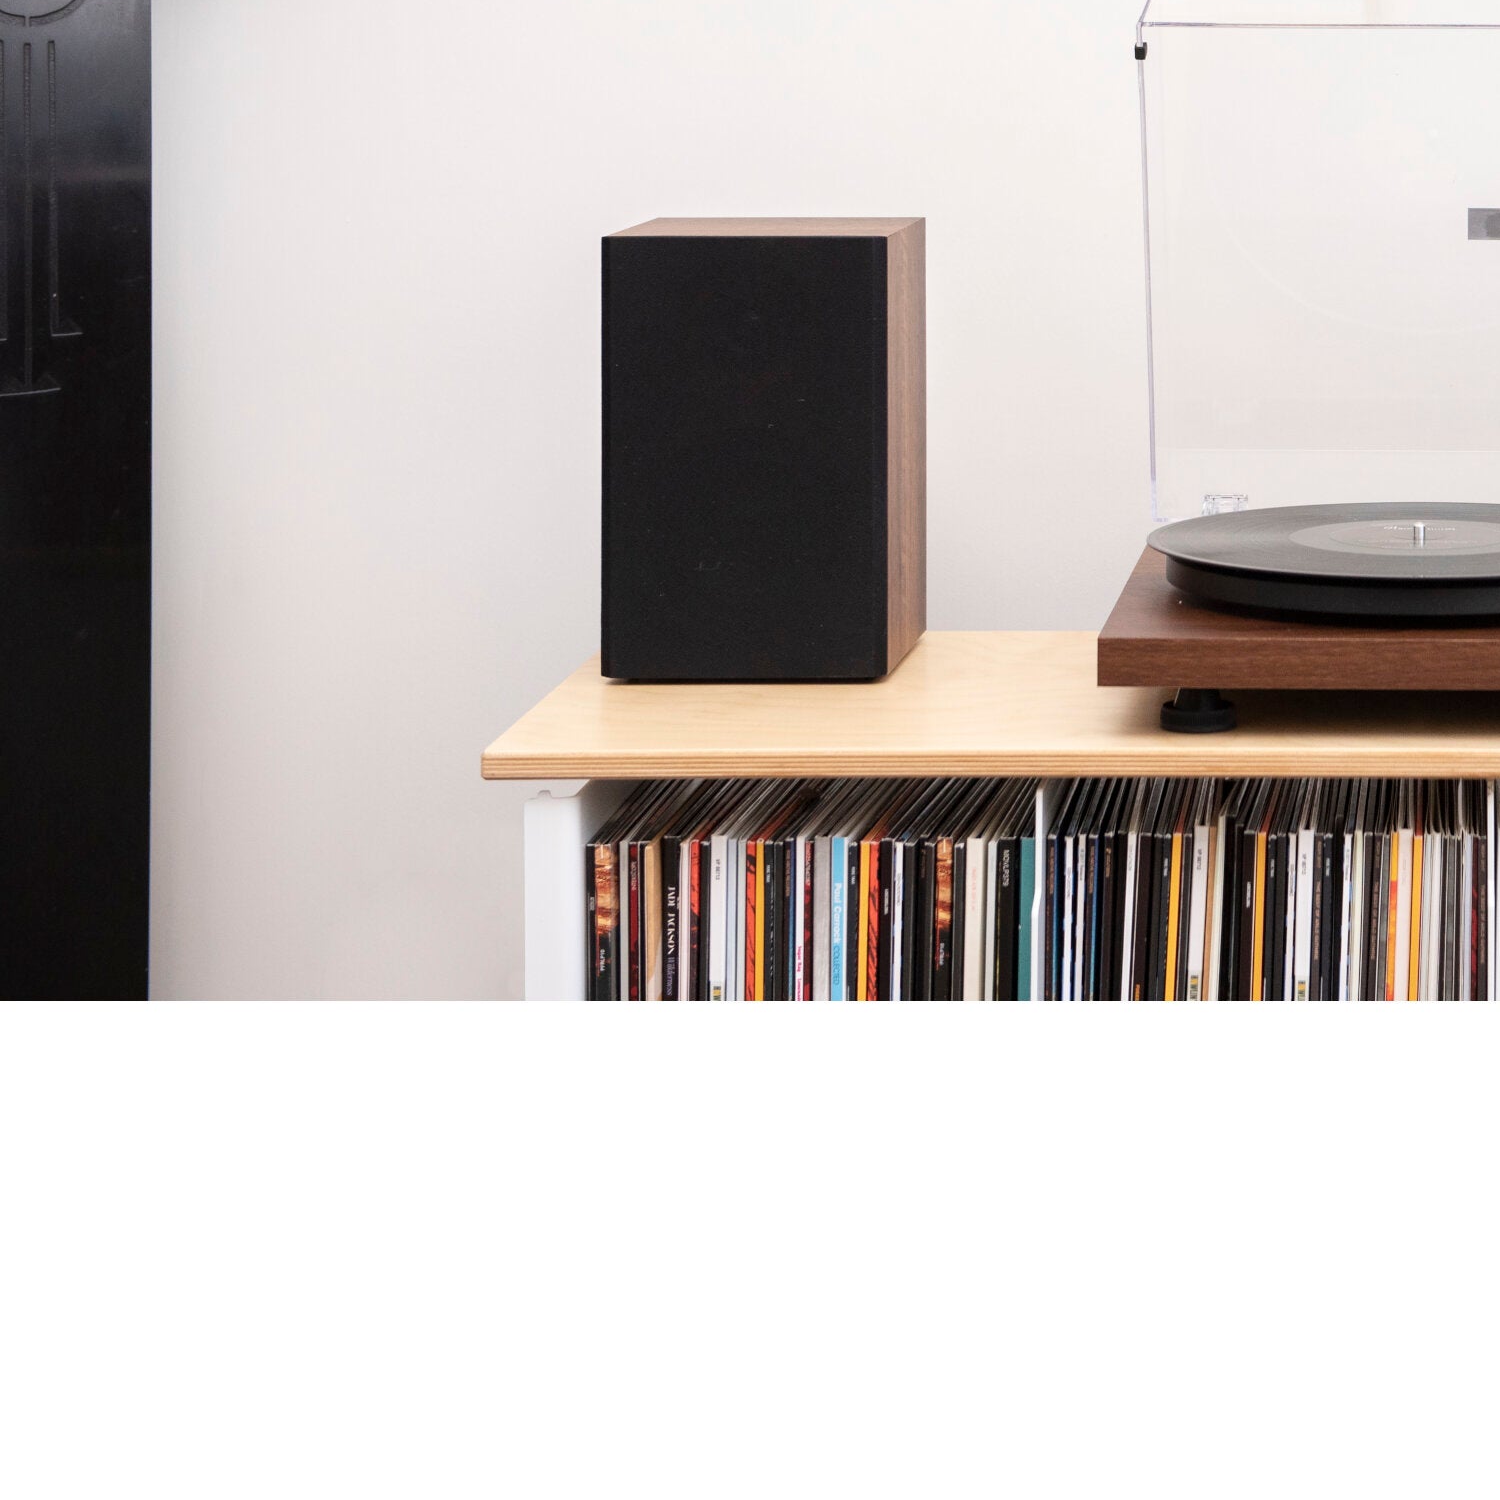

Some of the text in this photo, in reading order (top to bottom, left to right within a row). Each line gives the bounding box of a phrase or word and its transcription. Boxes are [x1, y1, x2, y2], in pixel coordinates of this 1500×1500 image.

[665, 886, 676, 996] JADE JACKSON Wilderness
[832, 882, 842, 986] Paul Carrack COLLECTED
